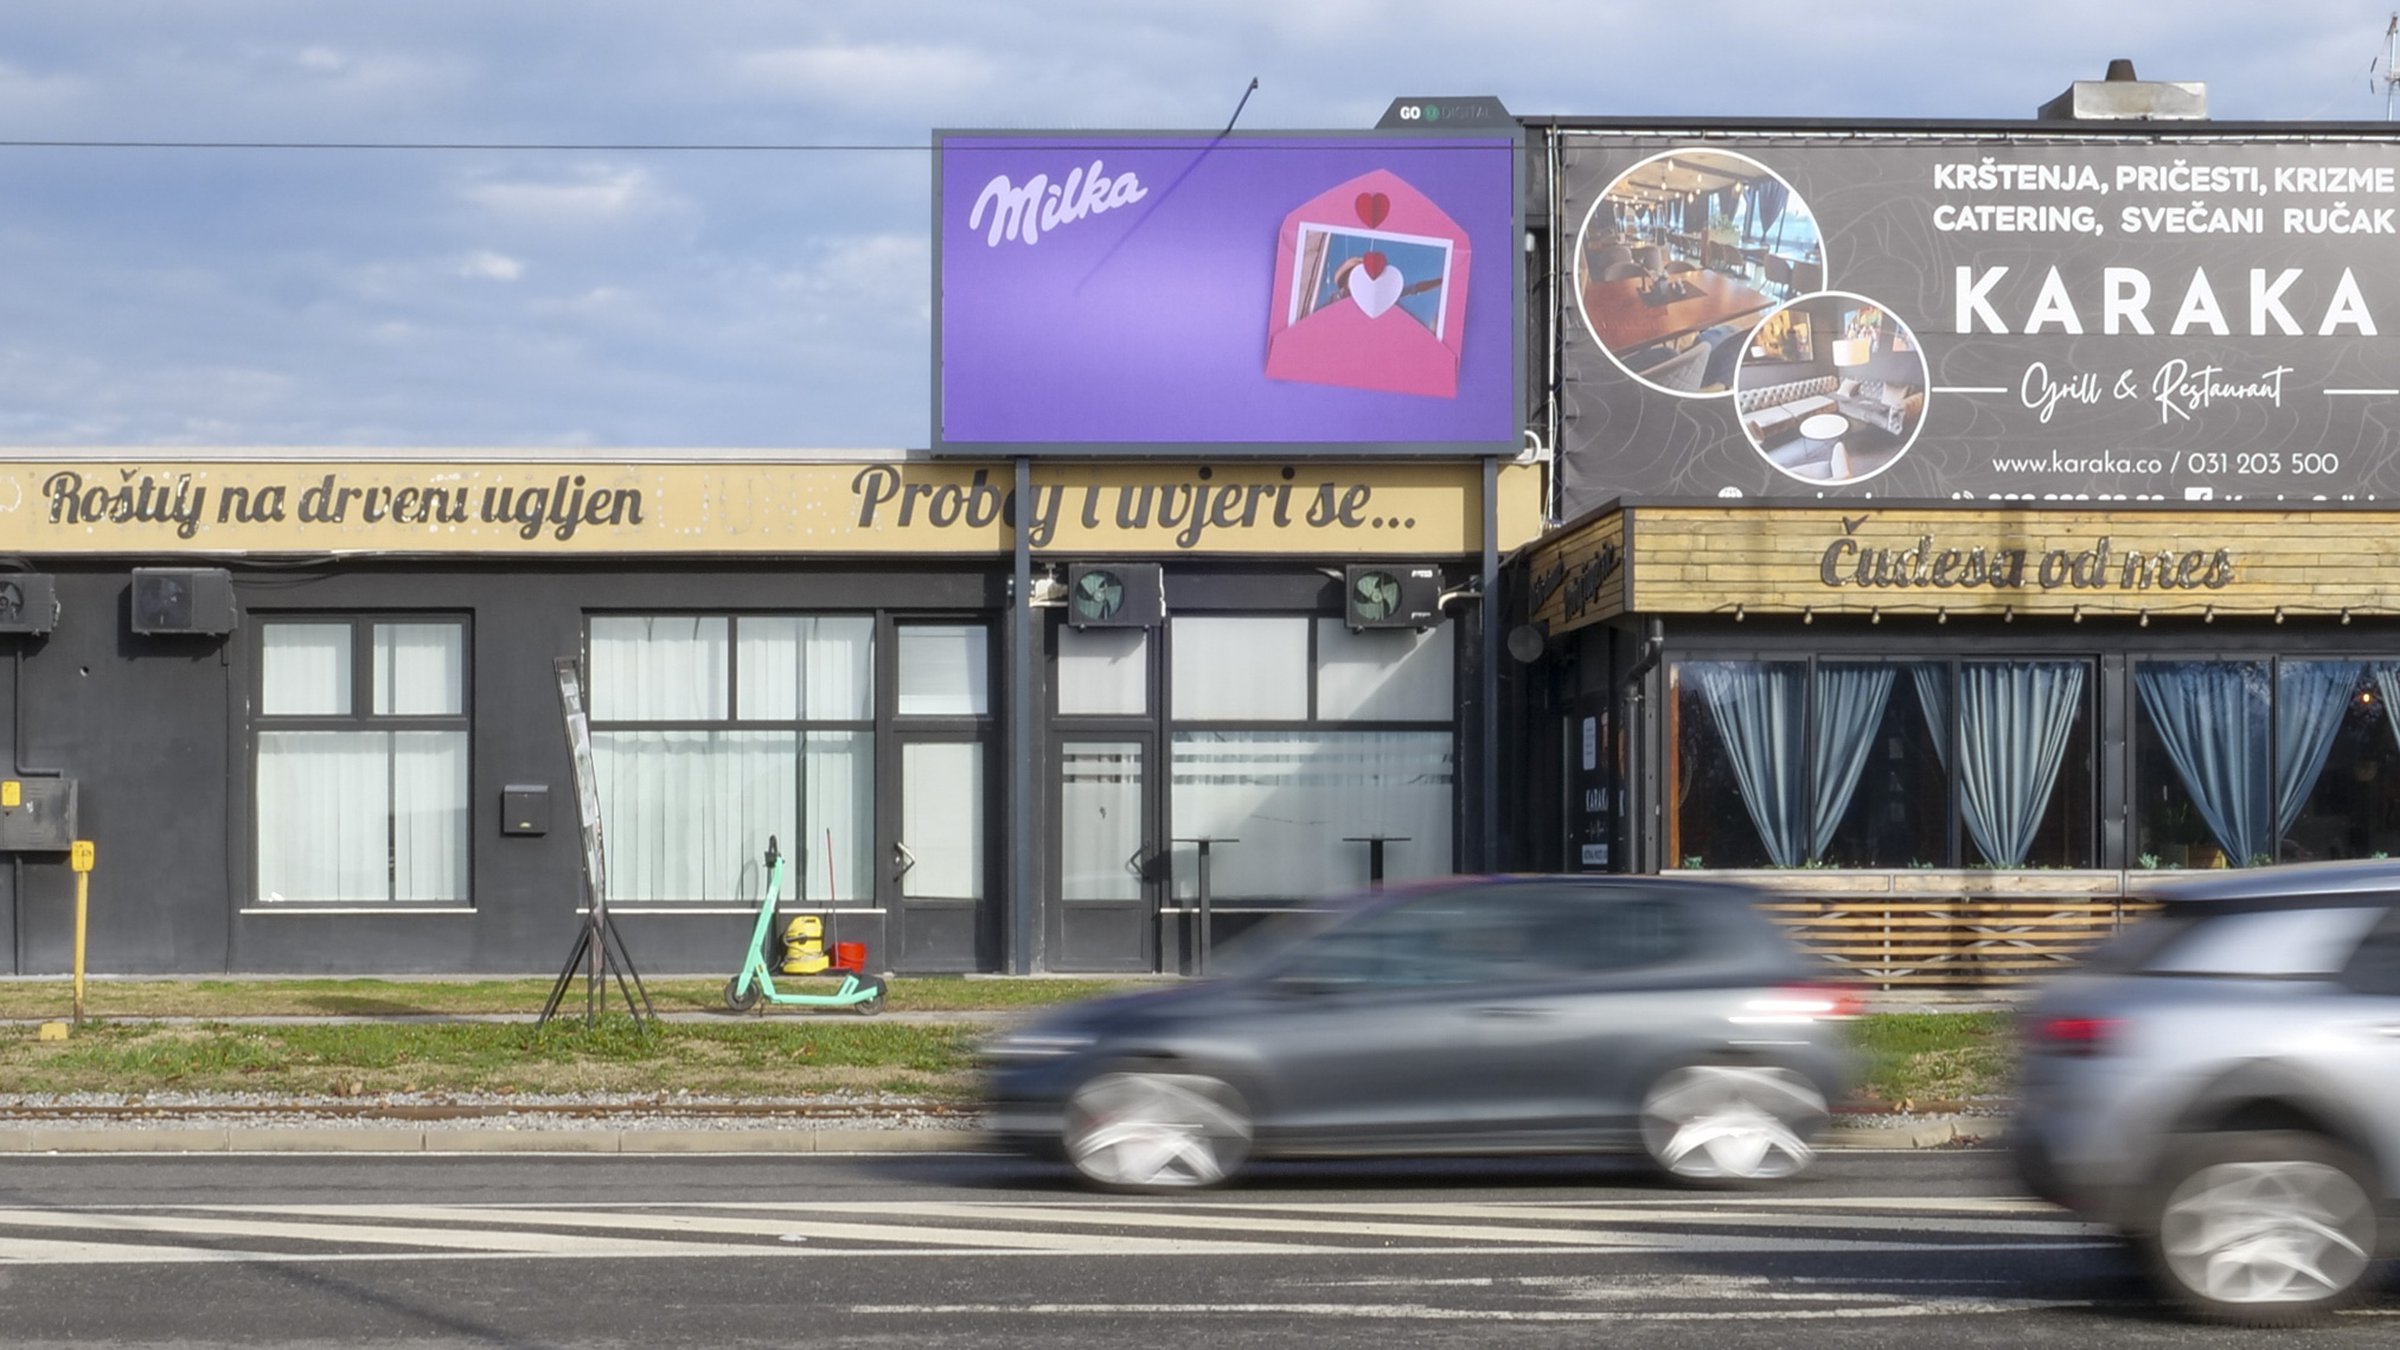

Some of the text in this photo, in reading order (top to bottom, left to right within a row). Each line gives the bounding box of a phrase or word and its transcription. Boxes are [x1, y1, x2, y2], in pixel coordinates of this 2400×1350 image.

[969, 160, 1148, 247] Milka
[1934, 157, 2396, 197] KRŠTENJA, PRIČESTI, KRIZME
[1933, 200, 2397, 236] CATERING, SVEČANI RUČAK
[1955, 265, 2378, 336] KARAKA
[2021, 358, 2294, 424] Grill & Restaurant
[1992, 449, 2162, 474] www.karaka.co
[2188, 452, 2227, 474] 031
[2236, 452, 2281, 474] 203
[2292, 453, 2339, 474] 500
[217, 485, 286, 523] na
[480, 475, 644, 541] ugljen
[1115, 466, 1295, 548] uvjeri
[1305, 482, 1415, 529] se...
[1819, 514, 2027, 588] Čudesa
[2038, 535, 2111, 589] od
